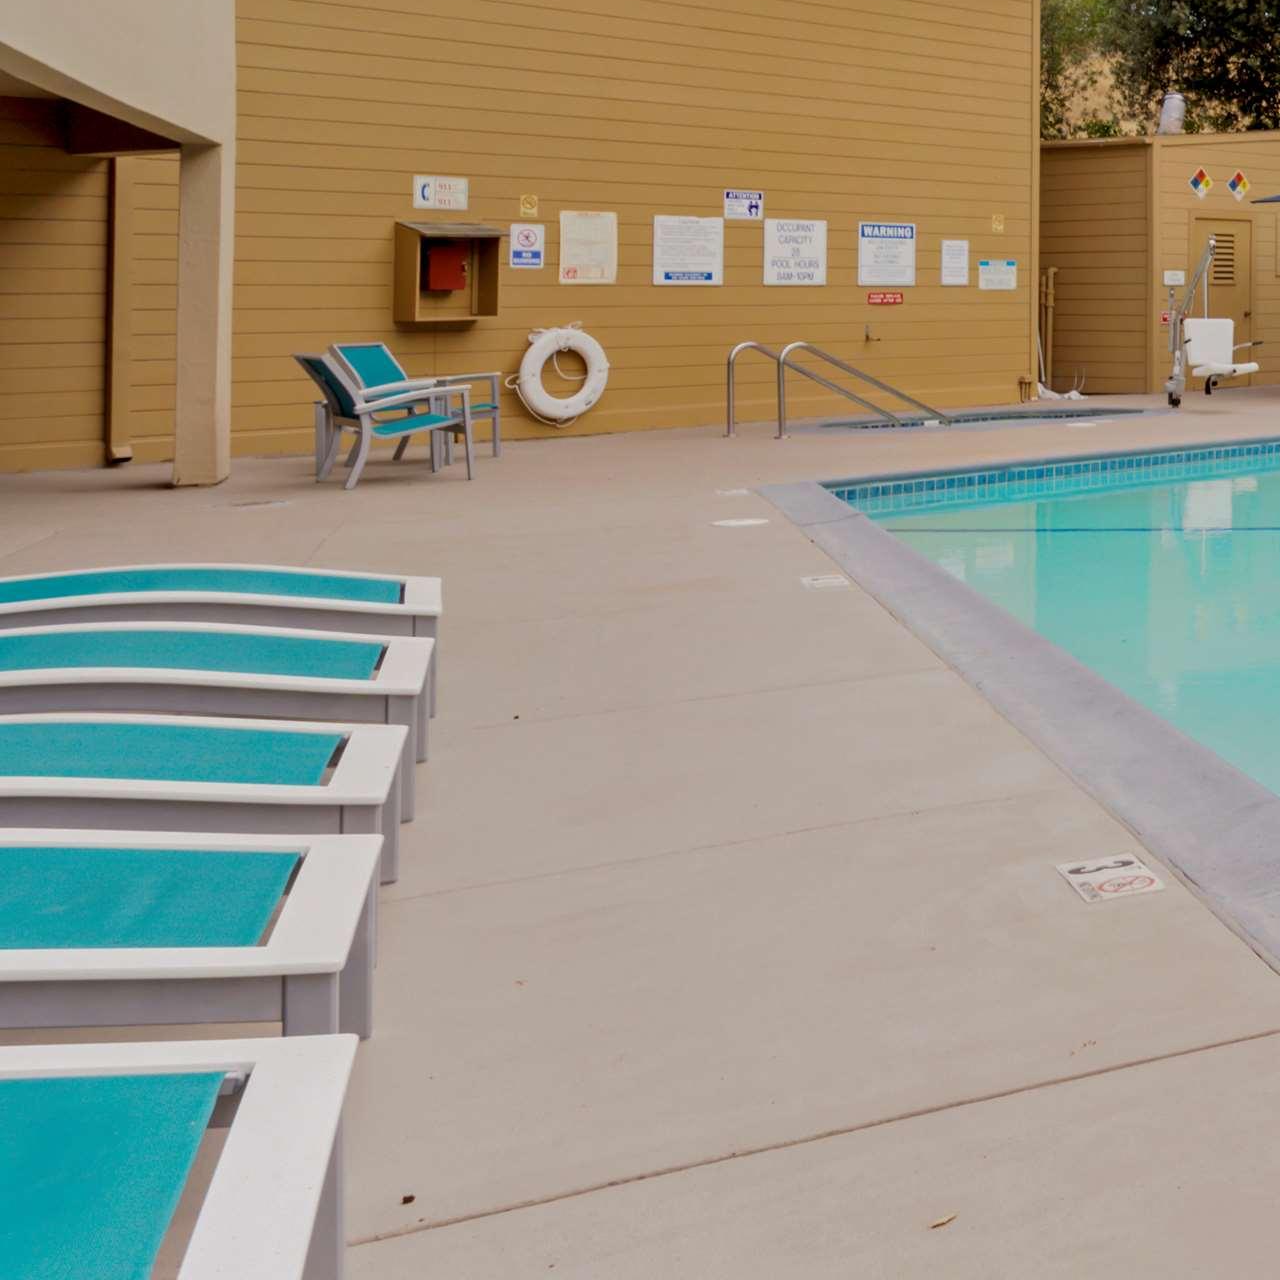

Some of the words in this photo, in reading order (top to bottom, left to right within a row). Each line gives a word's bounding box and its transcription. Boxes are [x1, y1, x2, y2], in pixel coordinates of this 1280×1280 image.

[728, 192, 760, 200] ATTENTION
[776, 223, 815, 233] OCCUPANT
[863, 225, 912, 237] WARNING
[778, 235, 813, 245] CAPACITY
[771, 260, 791, 269] POOL
[794, 260, 819, 269] HOURS
